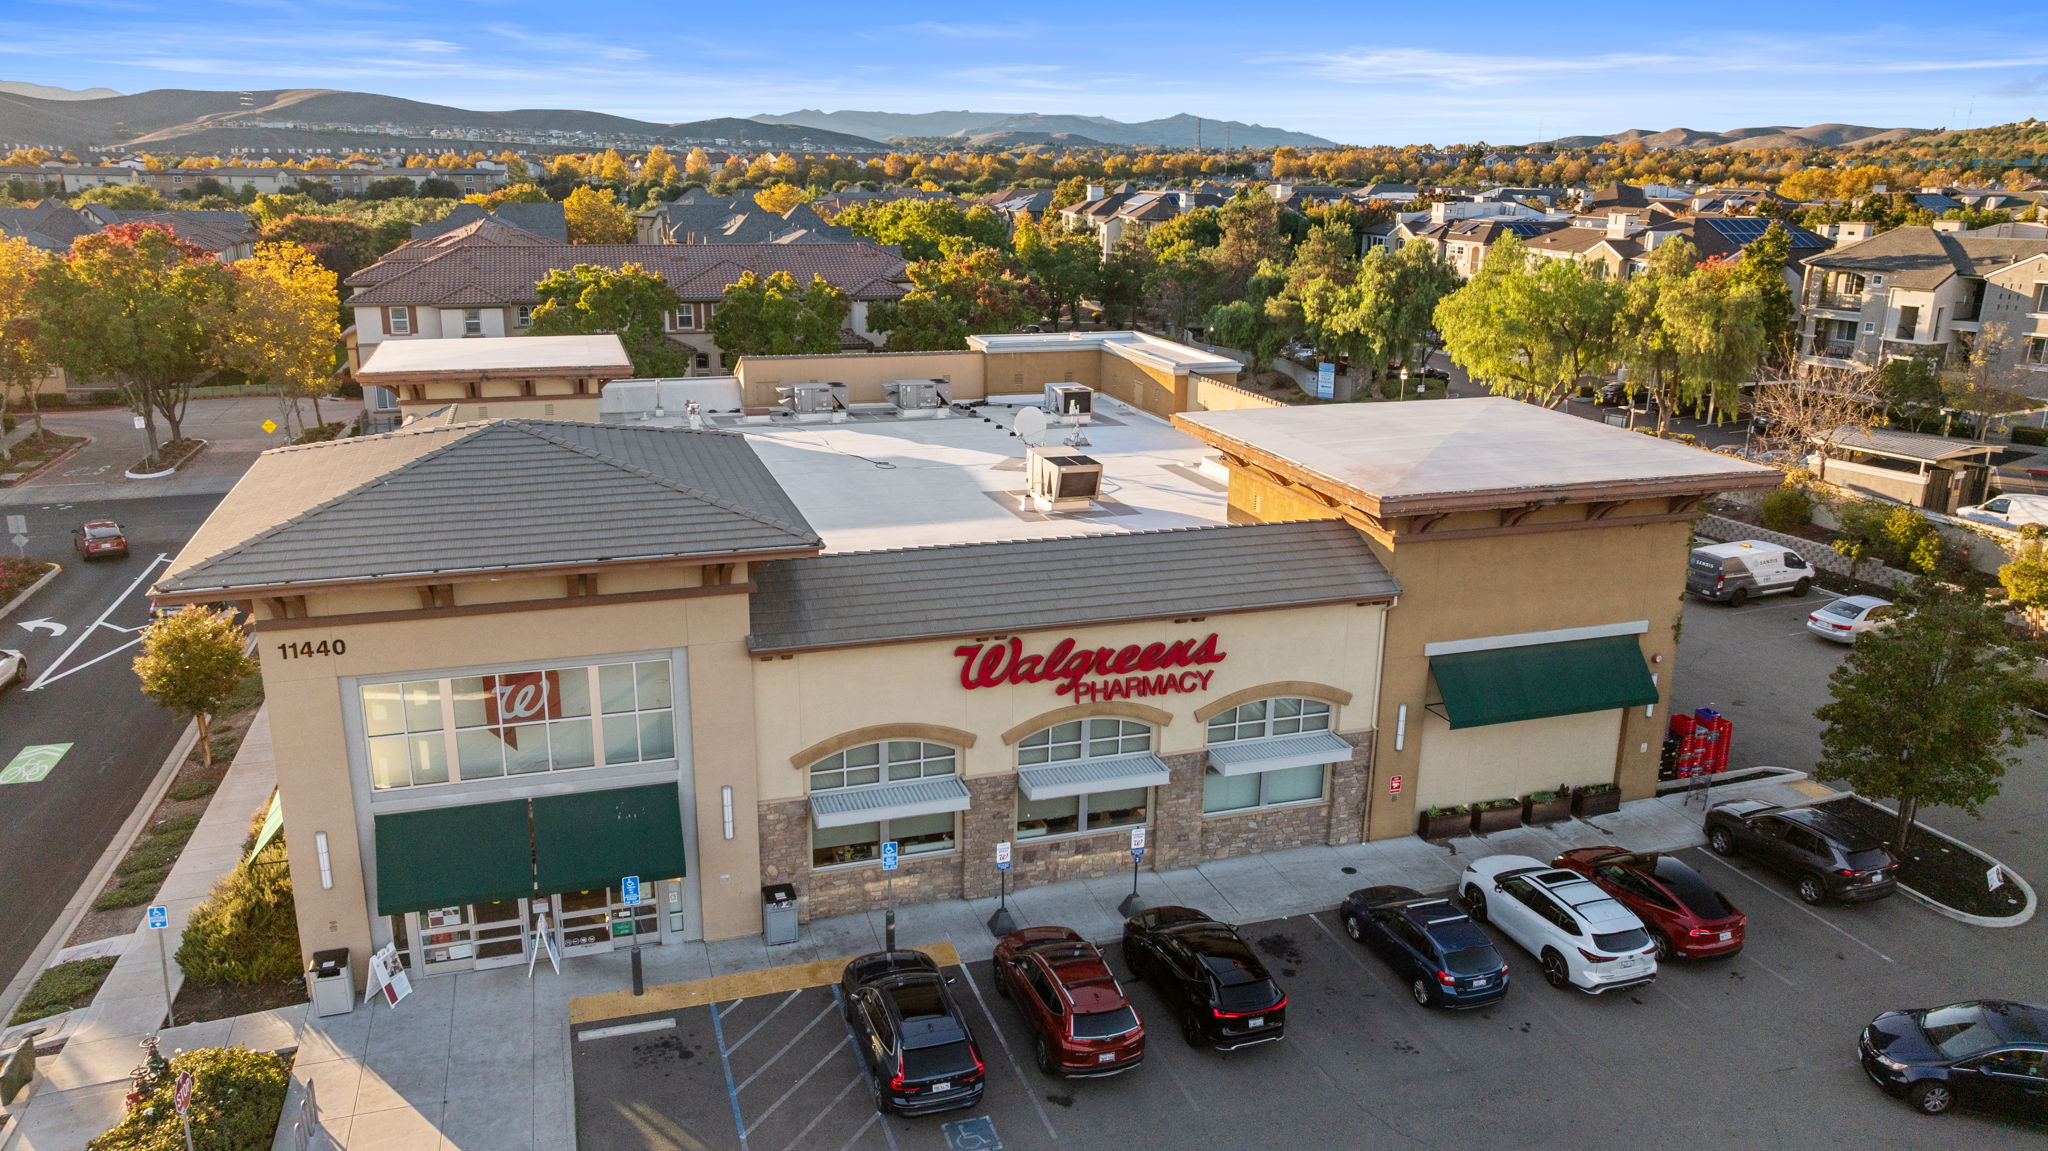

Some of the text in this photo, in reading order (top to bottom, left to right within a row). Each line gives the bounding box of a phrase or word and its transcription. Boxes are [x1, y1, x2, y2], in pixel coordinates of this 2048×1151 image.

[277, 639, 346, 659] 11440
[954, 633, 1227, 696] Walgreens
[1074, 669, 1214, 704] PHARMACY
[176, 1077, 191, 1107] STOP
